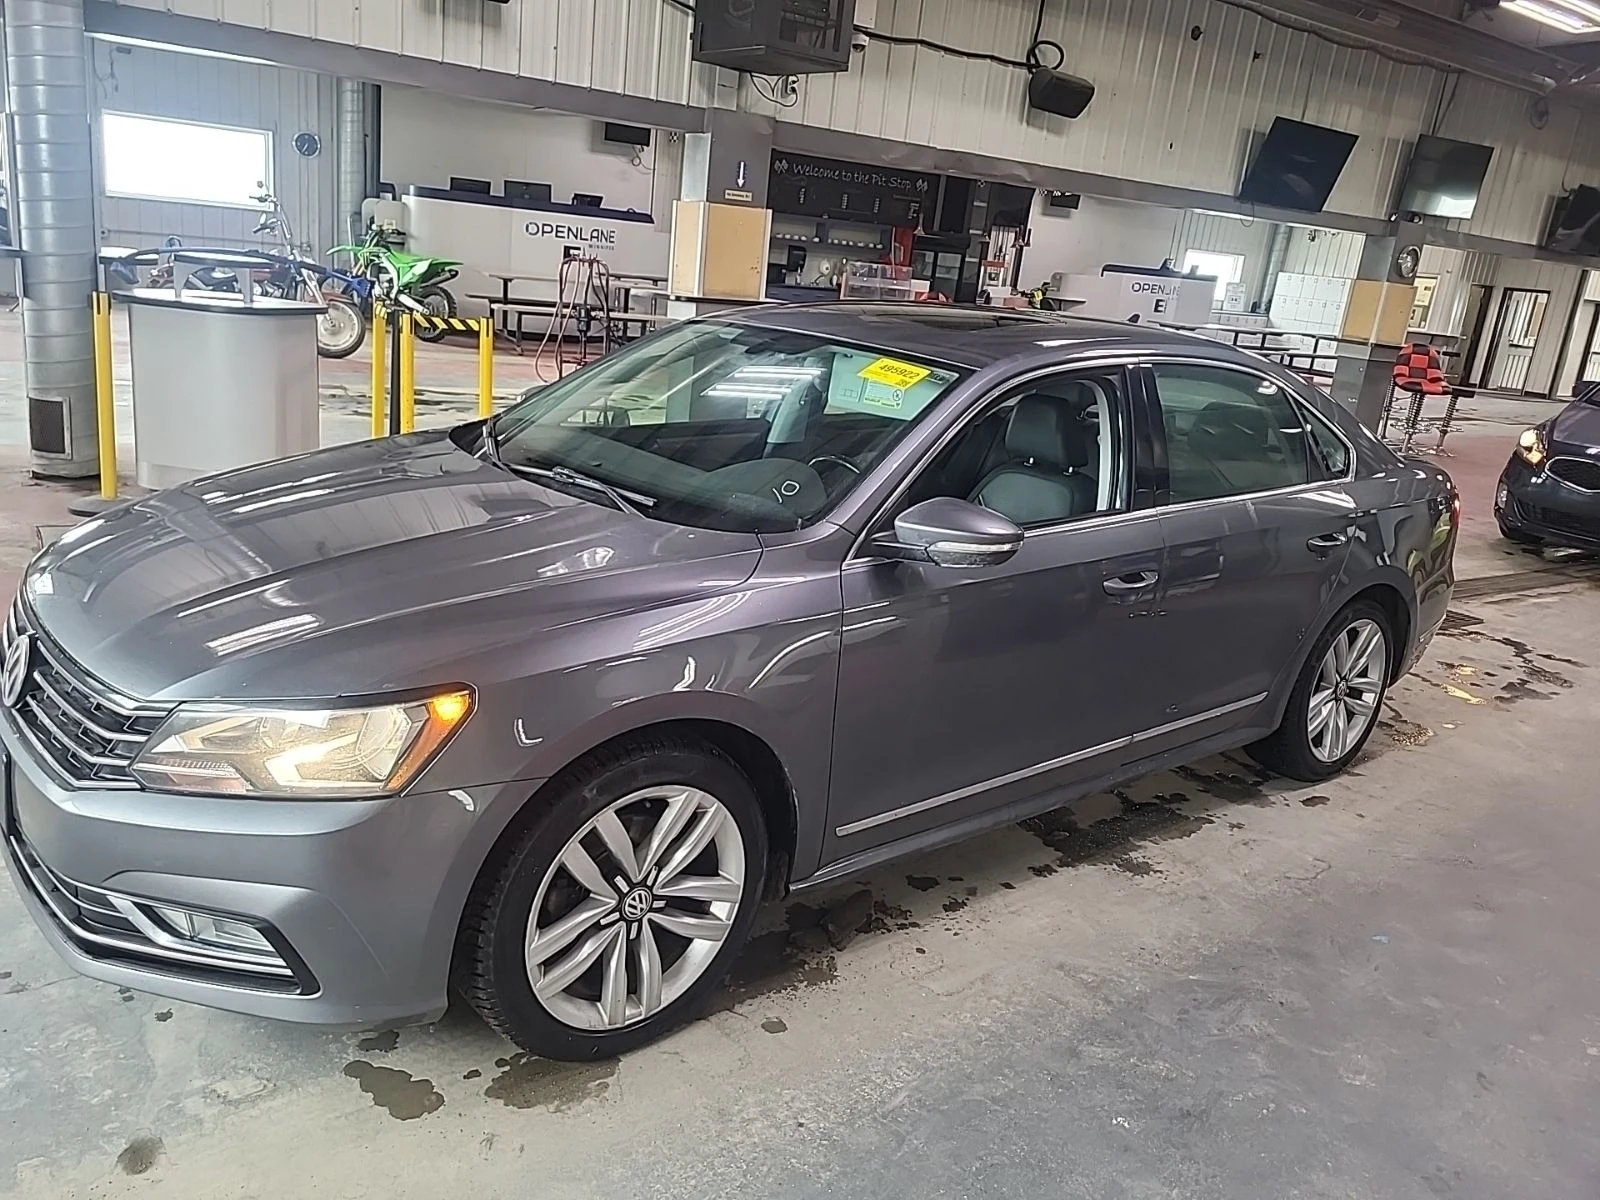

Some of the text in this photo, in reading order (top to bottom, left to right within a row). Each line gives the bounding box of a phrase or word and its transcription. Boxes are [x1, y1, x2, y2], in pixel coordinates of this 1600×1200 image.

[793, 163, 912, 191] Welcome to the Pit Stop
[525, 221, 616, 244] OPENLANE
[1131, 282, 1180, 297] OPEN
[879, 364, 921, 380] 495922
